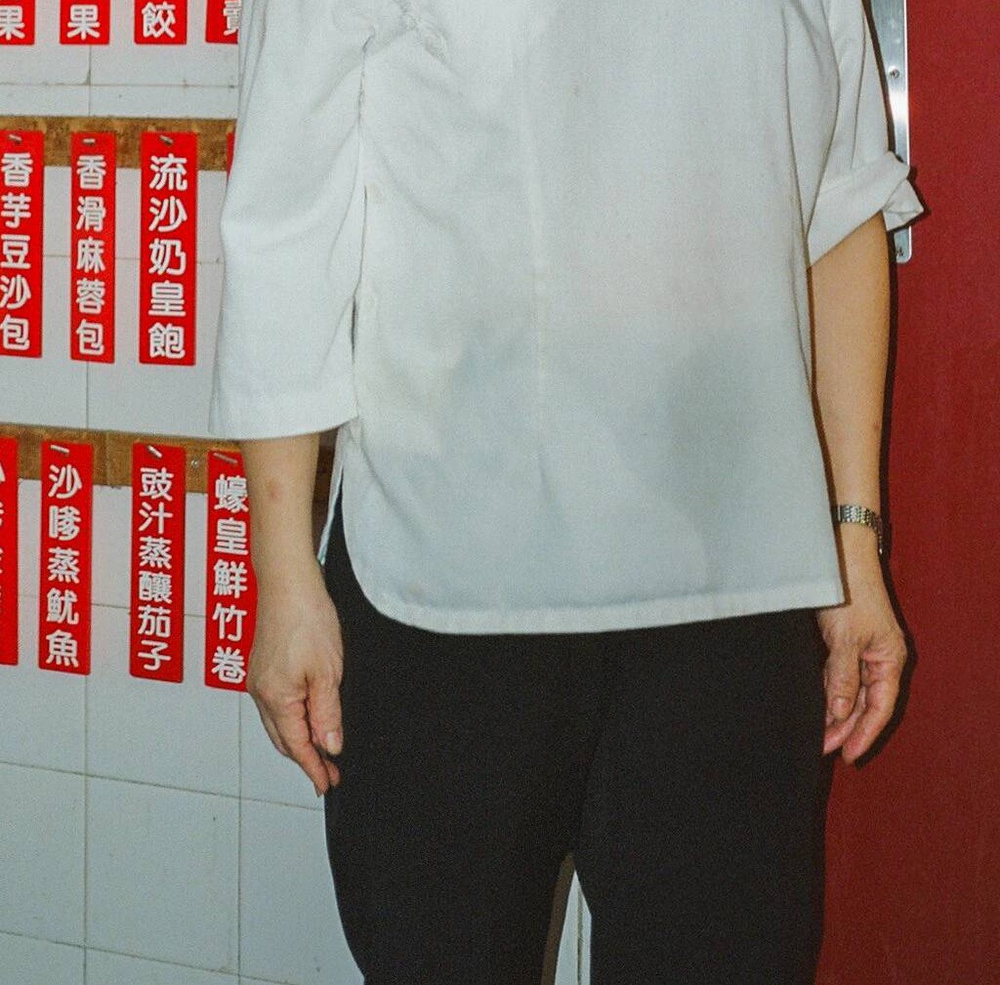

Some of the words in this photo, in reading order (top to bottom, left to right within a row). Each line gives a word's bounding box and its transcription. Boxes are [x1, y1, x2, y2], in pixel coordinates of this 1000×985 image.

[0, 153, 33, 350] 香芋豆沙包
[76, 155, 106, 355] 香滑麻蓉包
[149, 154, 187, 358] 流沙奶皇飽
[46, 465, 82, 667] 沙嗲蒸魷魚
[138, 468, 173, 670] 豉汁蒸釀茄子
